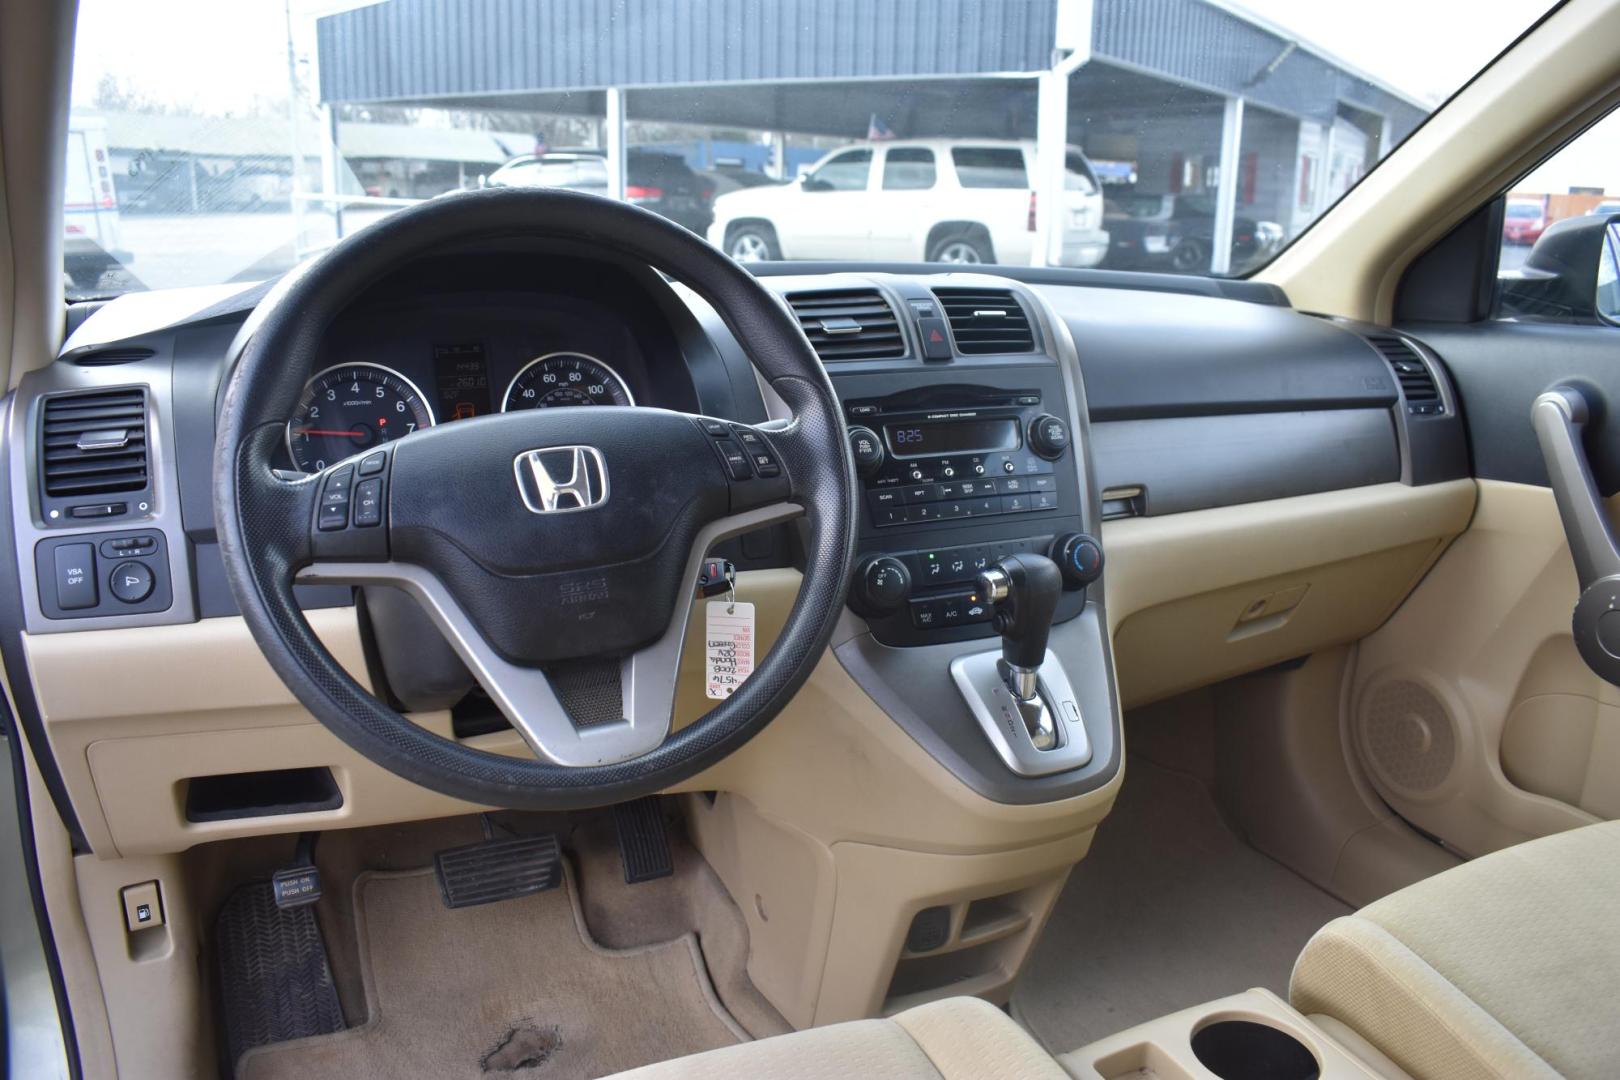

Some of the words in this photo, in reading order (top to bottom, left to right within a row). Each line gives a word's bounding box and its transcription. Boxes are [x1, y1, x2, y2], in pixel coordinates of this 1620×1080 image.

[543, 373, 556, 383] 60
[569, 372, 582, 381] 80
[351, 382, 360, 393] 4
[375, 387, 385, 398] 5
[588, 385, 604, 394] 100
[327, 390, 336, 400] 3
[522, 388, 535, 398] 40
[396, 401, 406, 412] 6
[310, 406, 319, 418] 2
[406, 423, 415, 434] 7
[316, 460, 325, 472] 0
[708, 640, 736, 650] Green
[709, 656, 737, 667] Honda
[713, 664, 737, 674] 2008
[280, 879, 299, 887] PUSH
[282, 888, 300, 897] PUSH
[302, 885, 314, 893] OFF
